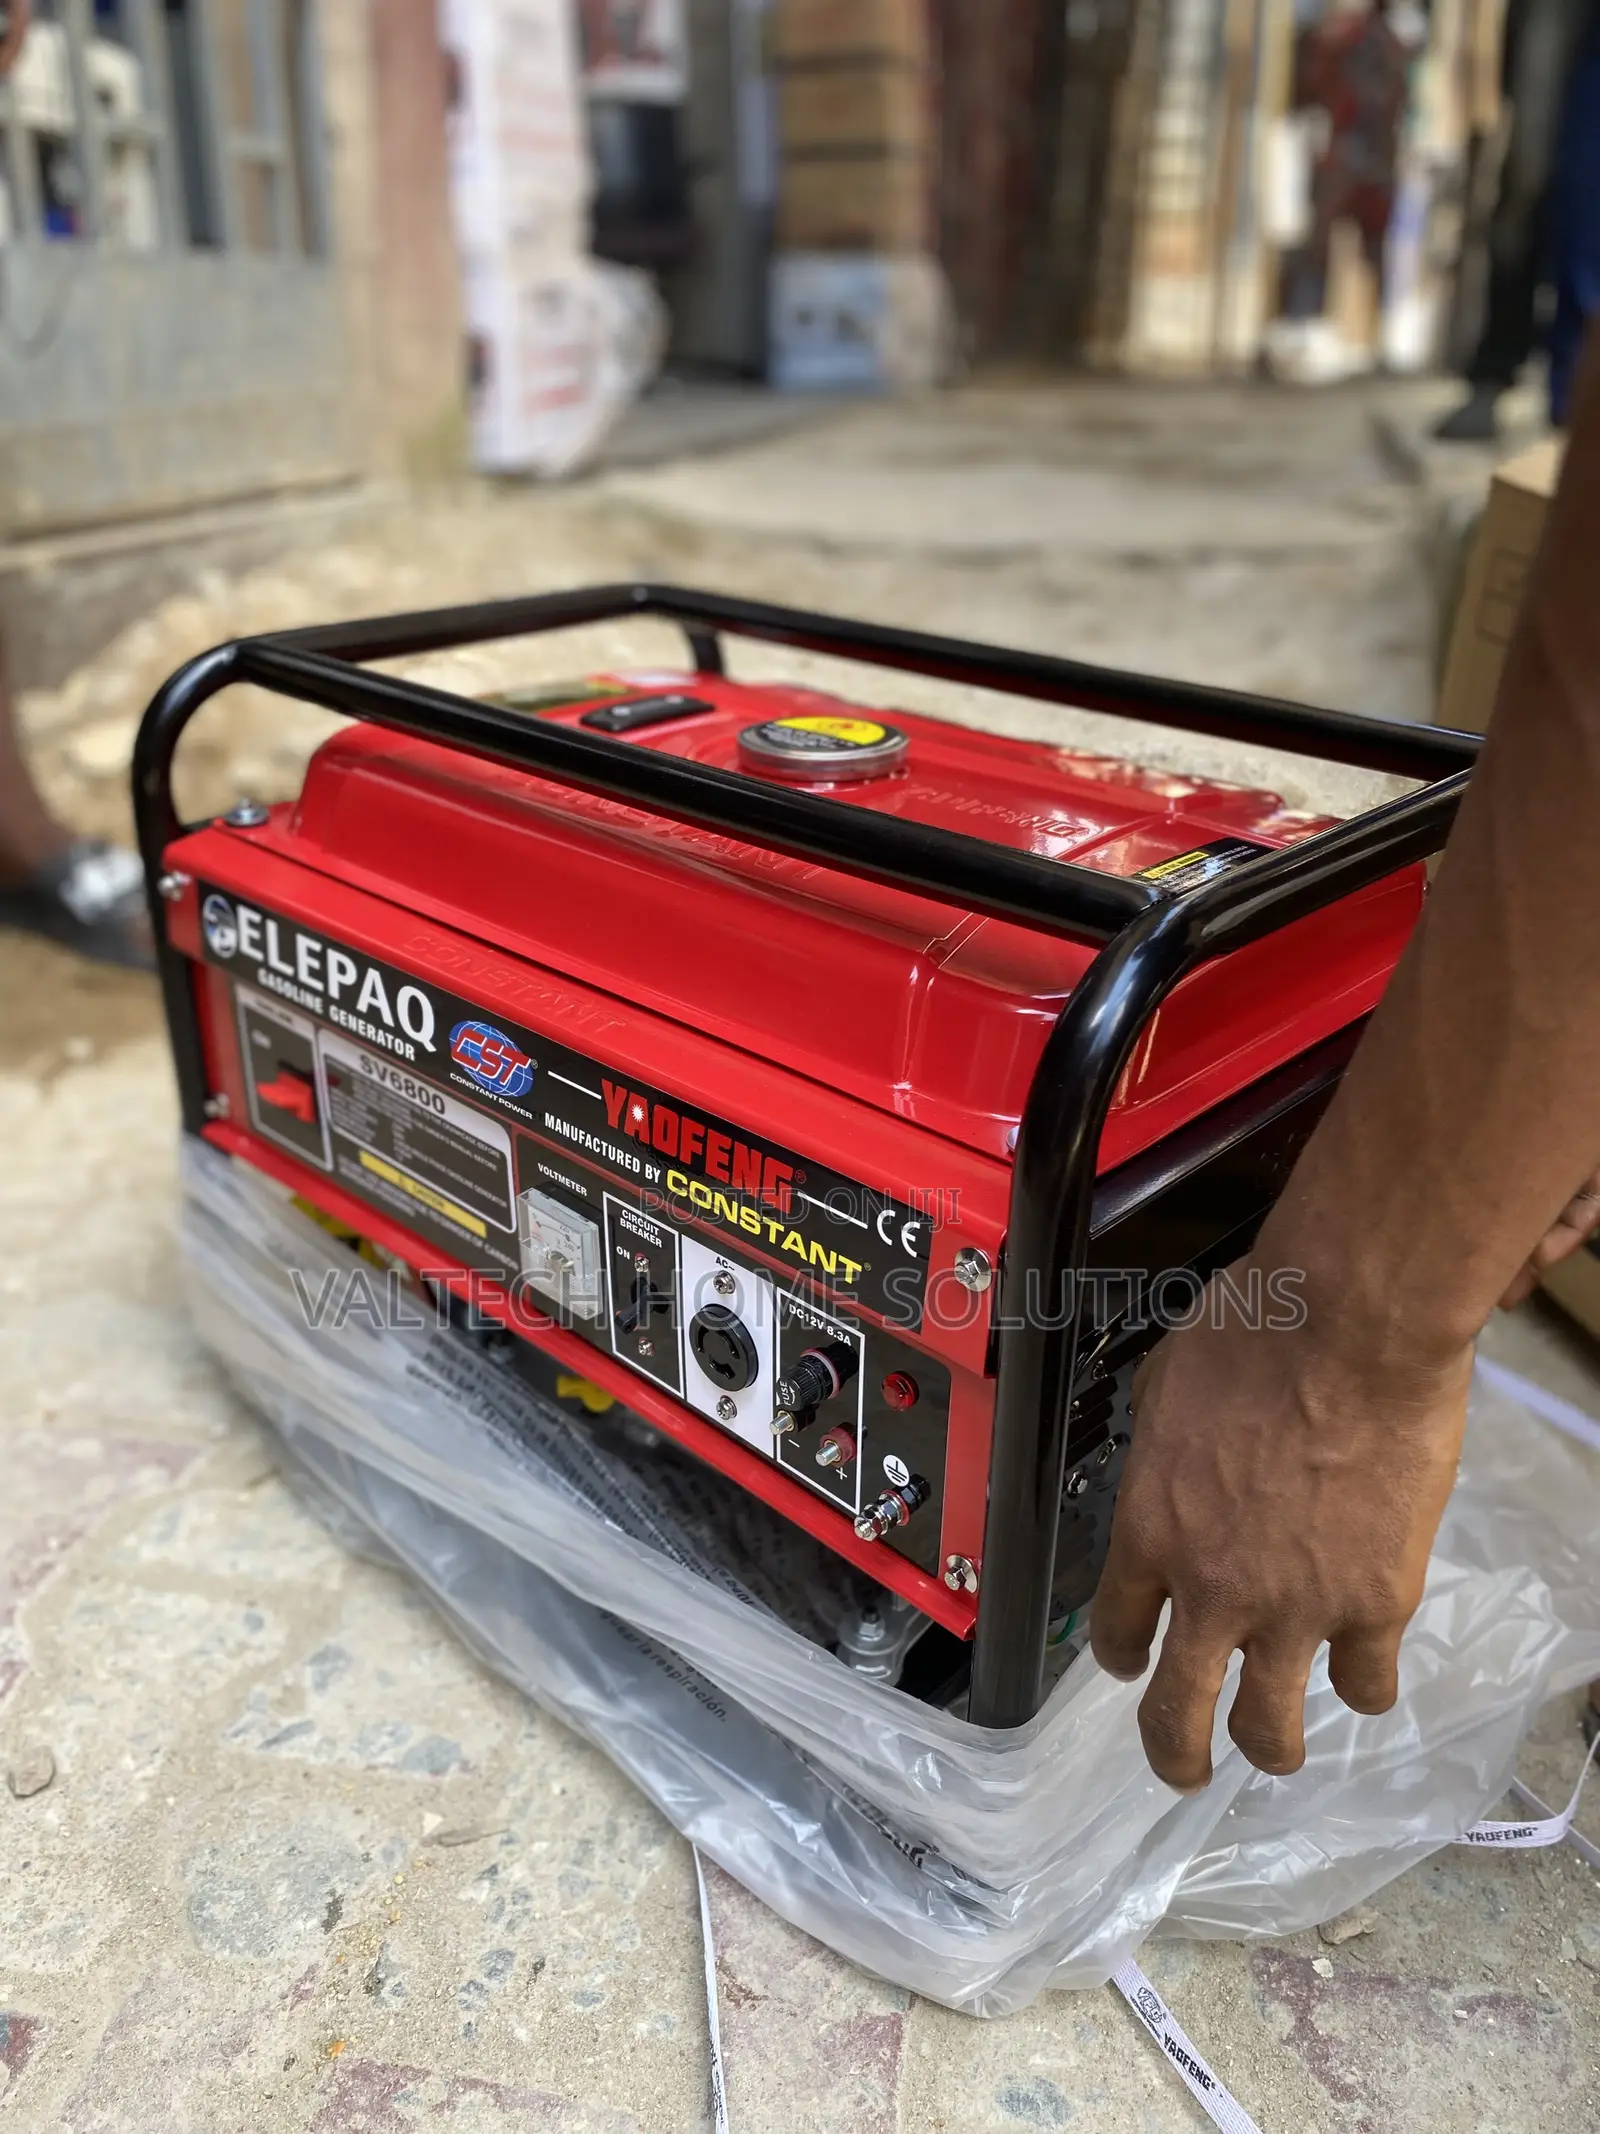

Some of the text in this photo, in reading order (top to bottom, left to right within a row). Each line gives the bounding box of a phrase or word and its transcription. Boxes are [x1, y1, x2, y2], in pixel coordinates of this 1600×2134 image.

[236, 904, 437, 1053] ELEPAQ
[257, 967, 325, 1015] GASOLINE
[329, 1005, 416, 1062] GENERATOR
[450, 1027, 532, 1087] CST
[359, 1052, 446, 1116] SV6800
[449, 1072, 533, 1120] CONSTANT POWER
[544, 1112, 662, 1184] MANUFACTURED BY
[601, 1078, 794, 1215] YAOFENG
[537, 1162, 588, 1197] VOLTMETER
[620, 1217, 663, 1248] BREAKER
[621, 1209, 660, 1237] CIRCUIT
[666, 1169, 863, 1285] CONSTANT
[616, 1246, 631, 1260] ON
[789, 1303, 852, 1347] DC12V 8.3A
[779, 1380, 792, 1406] FUSE
[1464, 1828, 1533, 1842] YAOFENG
[1163, 2032, 1212, 2091] YAOFENG
